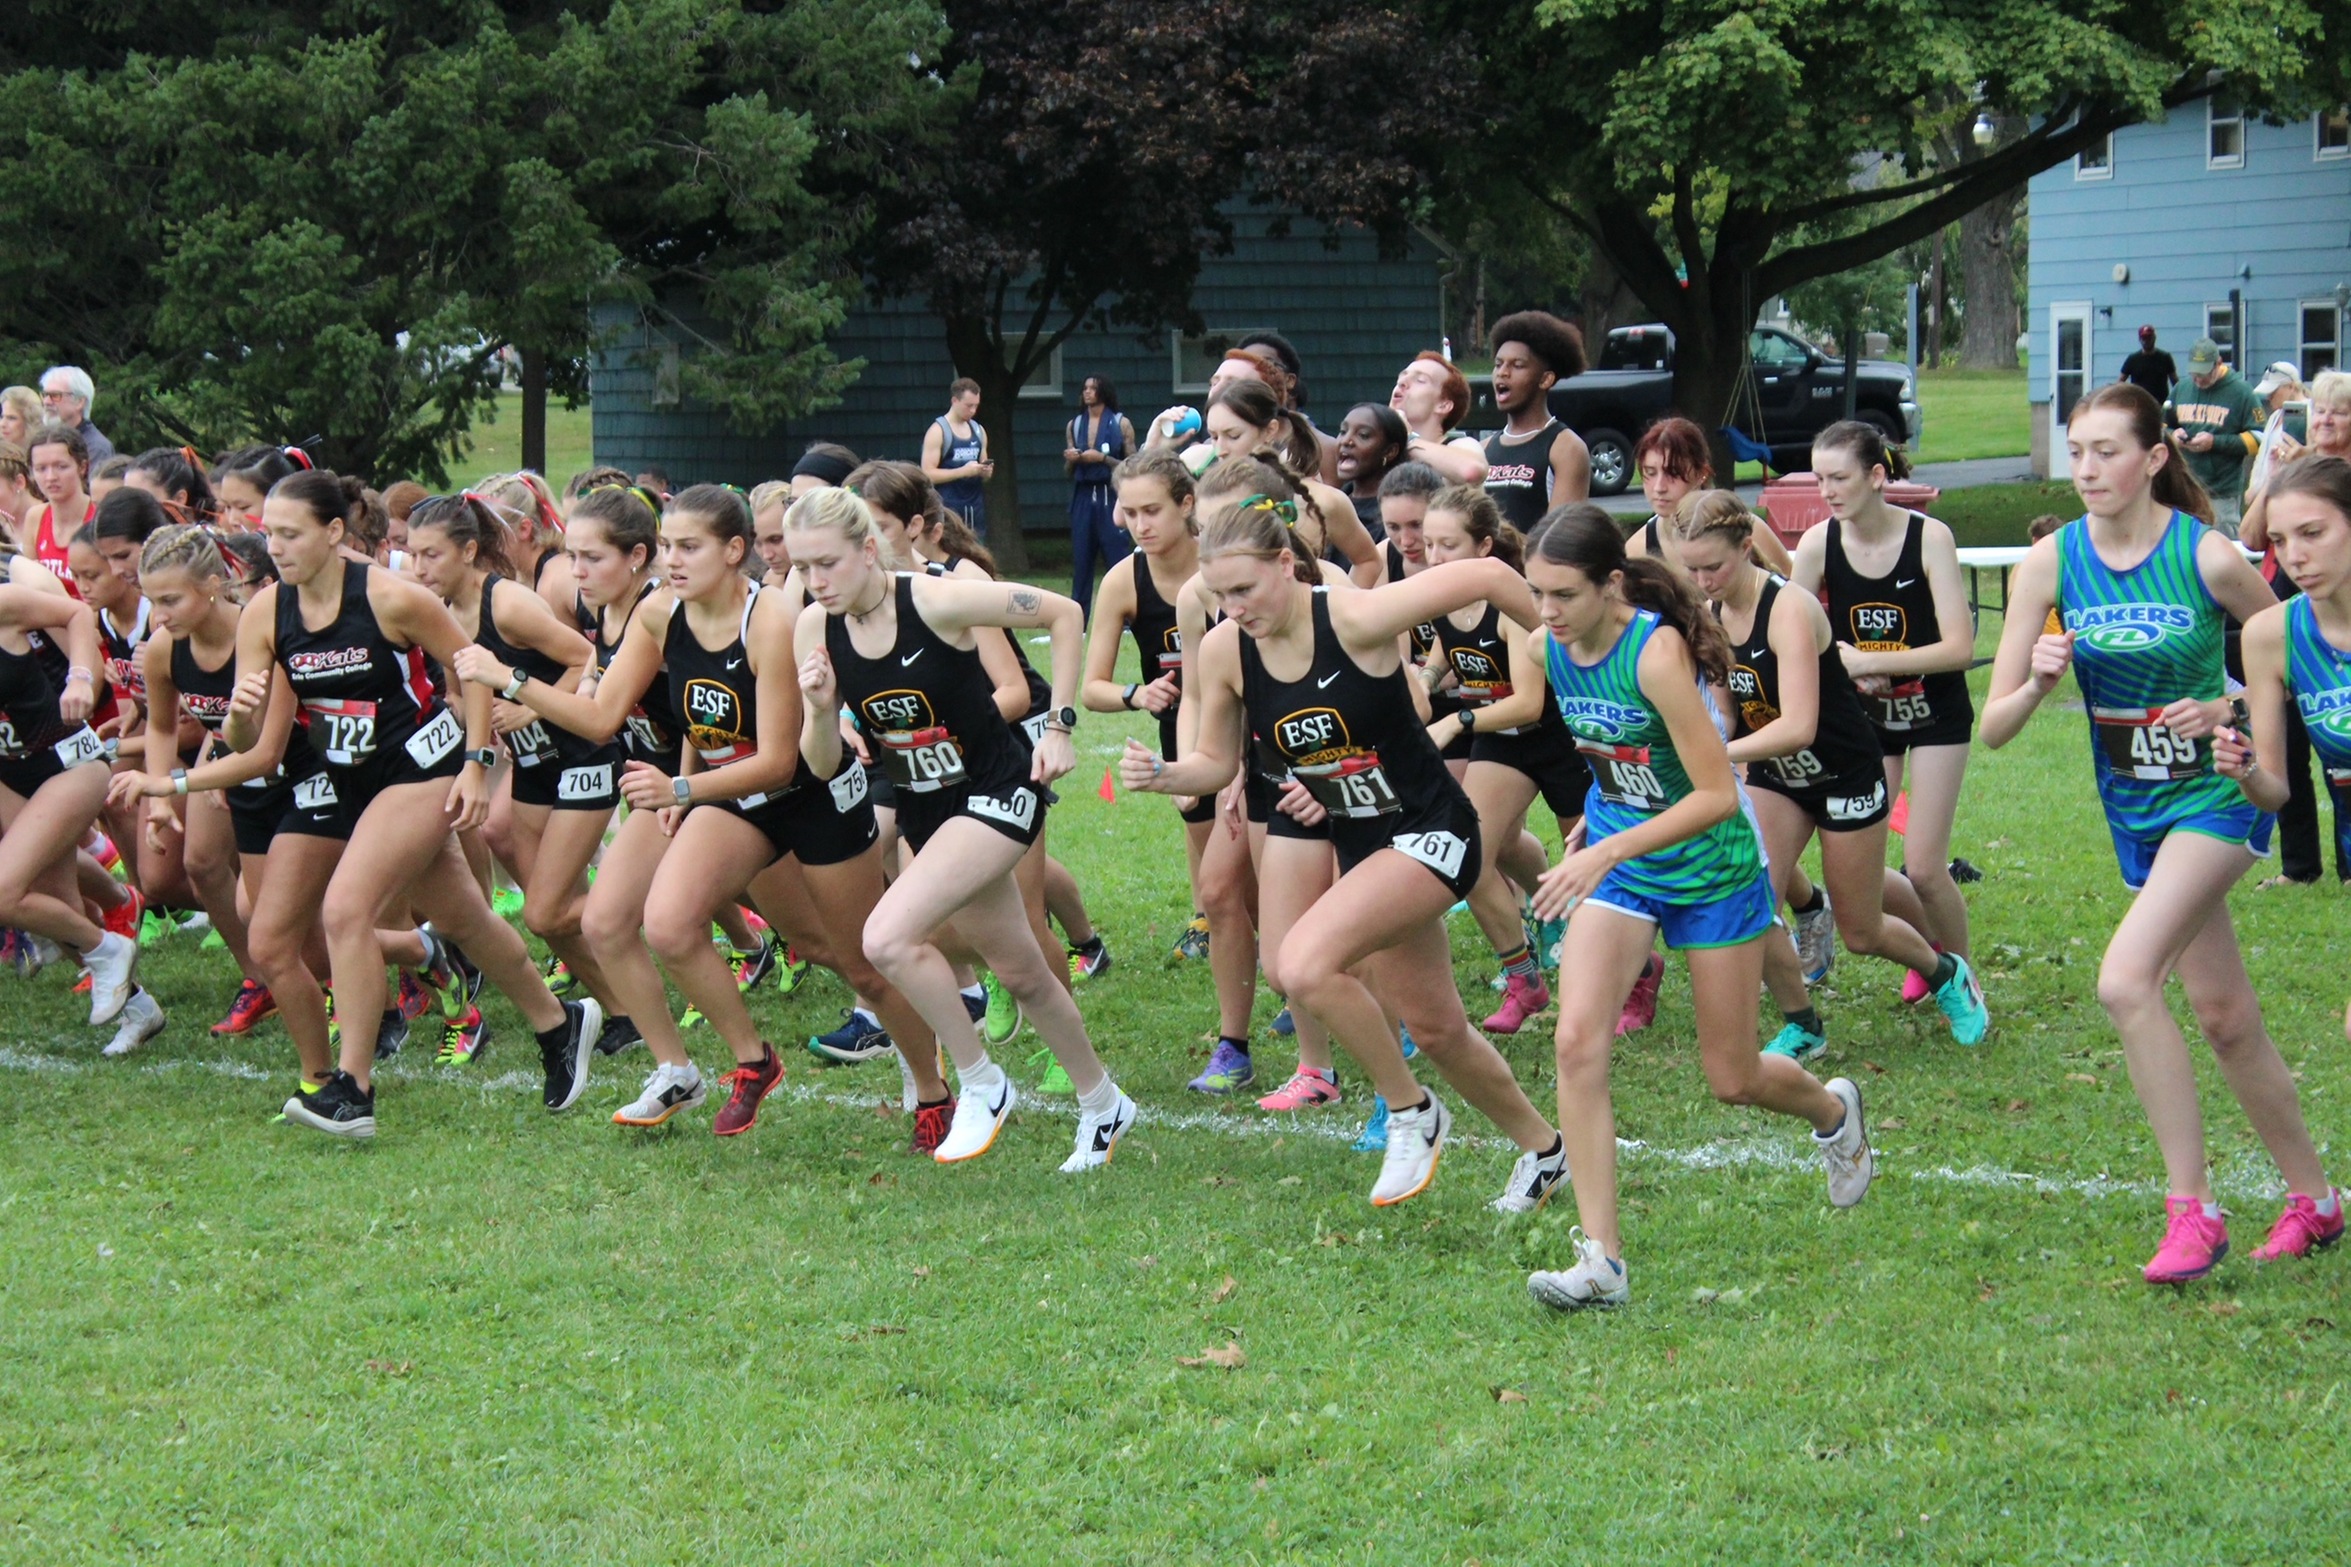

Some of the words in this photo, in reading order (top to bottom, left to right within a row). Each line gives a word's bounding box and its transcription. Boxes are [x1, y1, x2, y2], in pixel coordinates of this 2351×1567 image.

[1857, 608, 1898, 629] ESF
[2065, 604, 2193, 630] LAKERS
[1860, 642, 1903, 651] MIGHTY
[2100, 629, 2146, 645] FL
[1455, 652, 1489, 674] ESF
[1728, 671, 1755, 693] ESF
[691, 684, 731, 717] ESF
[869, 695, 920, 721] ESF
[1878, 693, 1931, 722] 755
[324, 714, 377, 752] 722
[420, 720, 455, 755] 722
[1282, 713, 1334, 748] ESF
[69, 733, 99, 759] 782
[2131, 725, 2197, 765] 459
[896, 741, 962, 780] 760
[1770, 749, 1823, 778] 759
[305, 776, 333, 799] 72
[570, 771, 602, 792] 704
[1328, 767, 1395, 807] 761
[1609, 760, 1665, 798] 460
